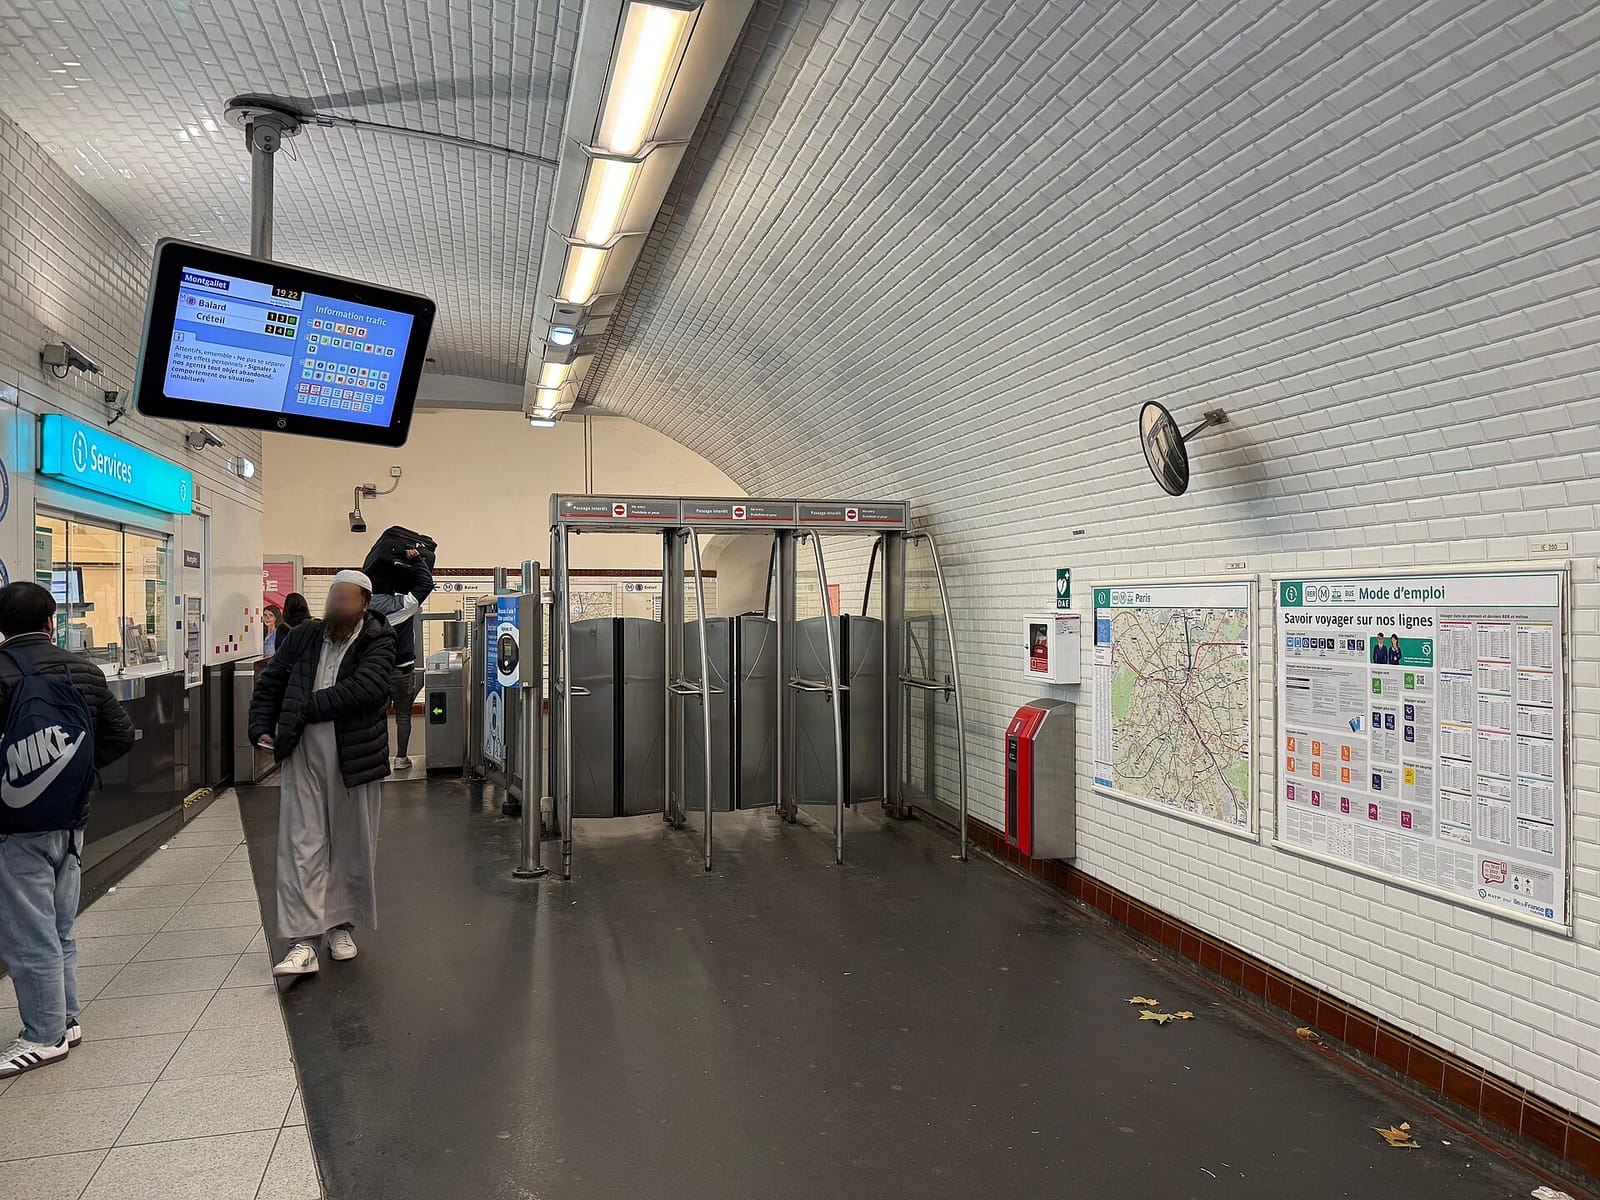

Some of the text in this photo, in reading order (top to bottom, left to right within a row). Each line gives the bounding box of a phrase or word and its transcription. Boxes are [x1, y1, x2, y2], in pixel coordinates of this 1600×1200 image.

[184, 273, 227, 290] Montgallet
[276, 288, 298, 300] 19:22
[198, 299, 227, 311] Balard
[196, 312, 226, 324] Créteil
[316, 305, 388, 326] Information trafic
[175, 344, 203, 354] Attentifs,
[204, 350, 232, 359] ensemble
[265, 360, 286, 368] séparer
[194, 355, 210, 363] effets
[211, 358, 243, 368] personnels
[248, 364, 271, 372] Signaler
[170, 373, 206, 384] inhabituels
[171, 366, 218, 379] comportement
[228, 374, 255, 383] situation
[185, 362, 206, 370] agents
[222, 366, 238, 375] objet
[239, 369, 274, 380] abandonné,
[91, 444, 132, 483] Services
[1136, 593, 1150, 602] Paris
[1359, 588, 1390, 600] Mode
[1394, 585, 1445, 602] d'emploi
[1284, 613, 1433, 629] Savoir voyager sur nos lignes
[6, 725, 74, 782] NIKE
